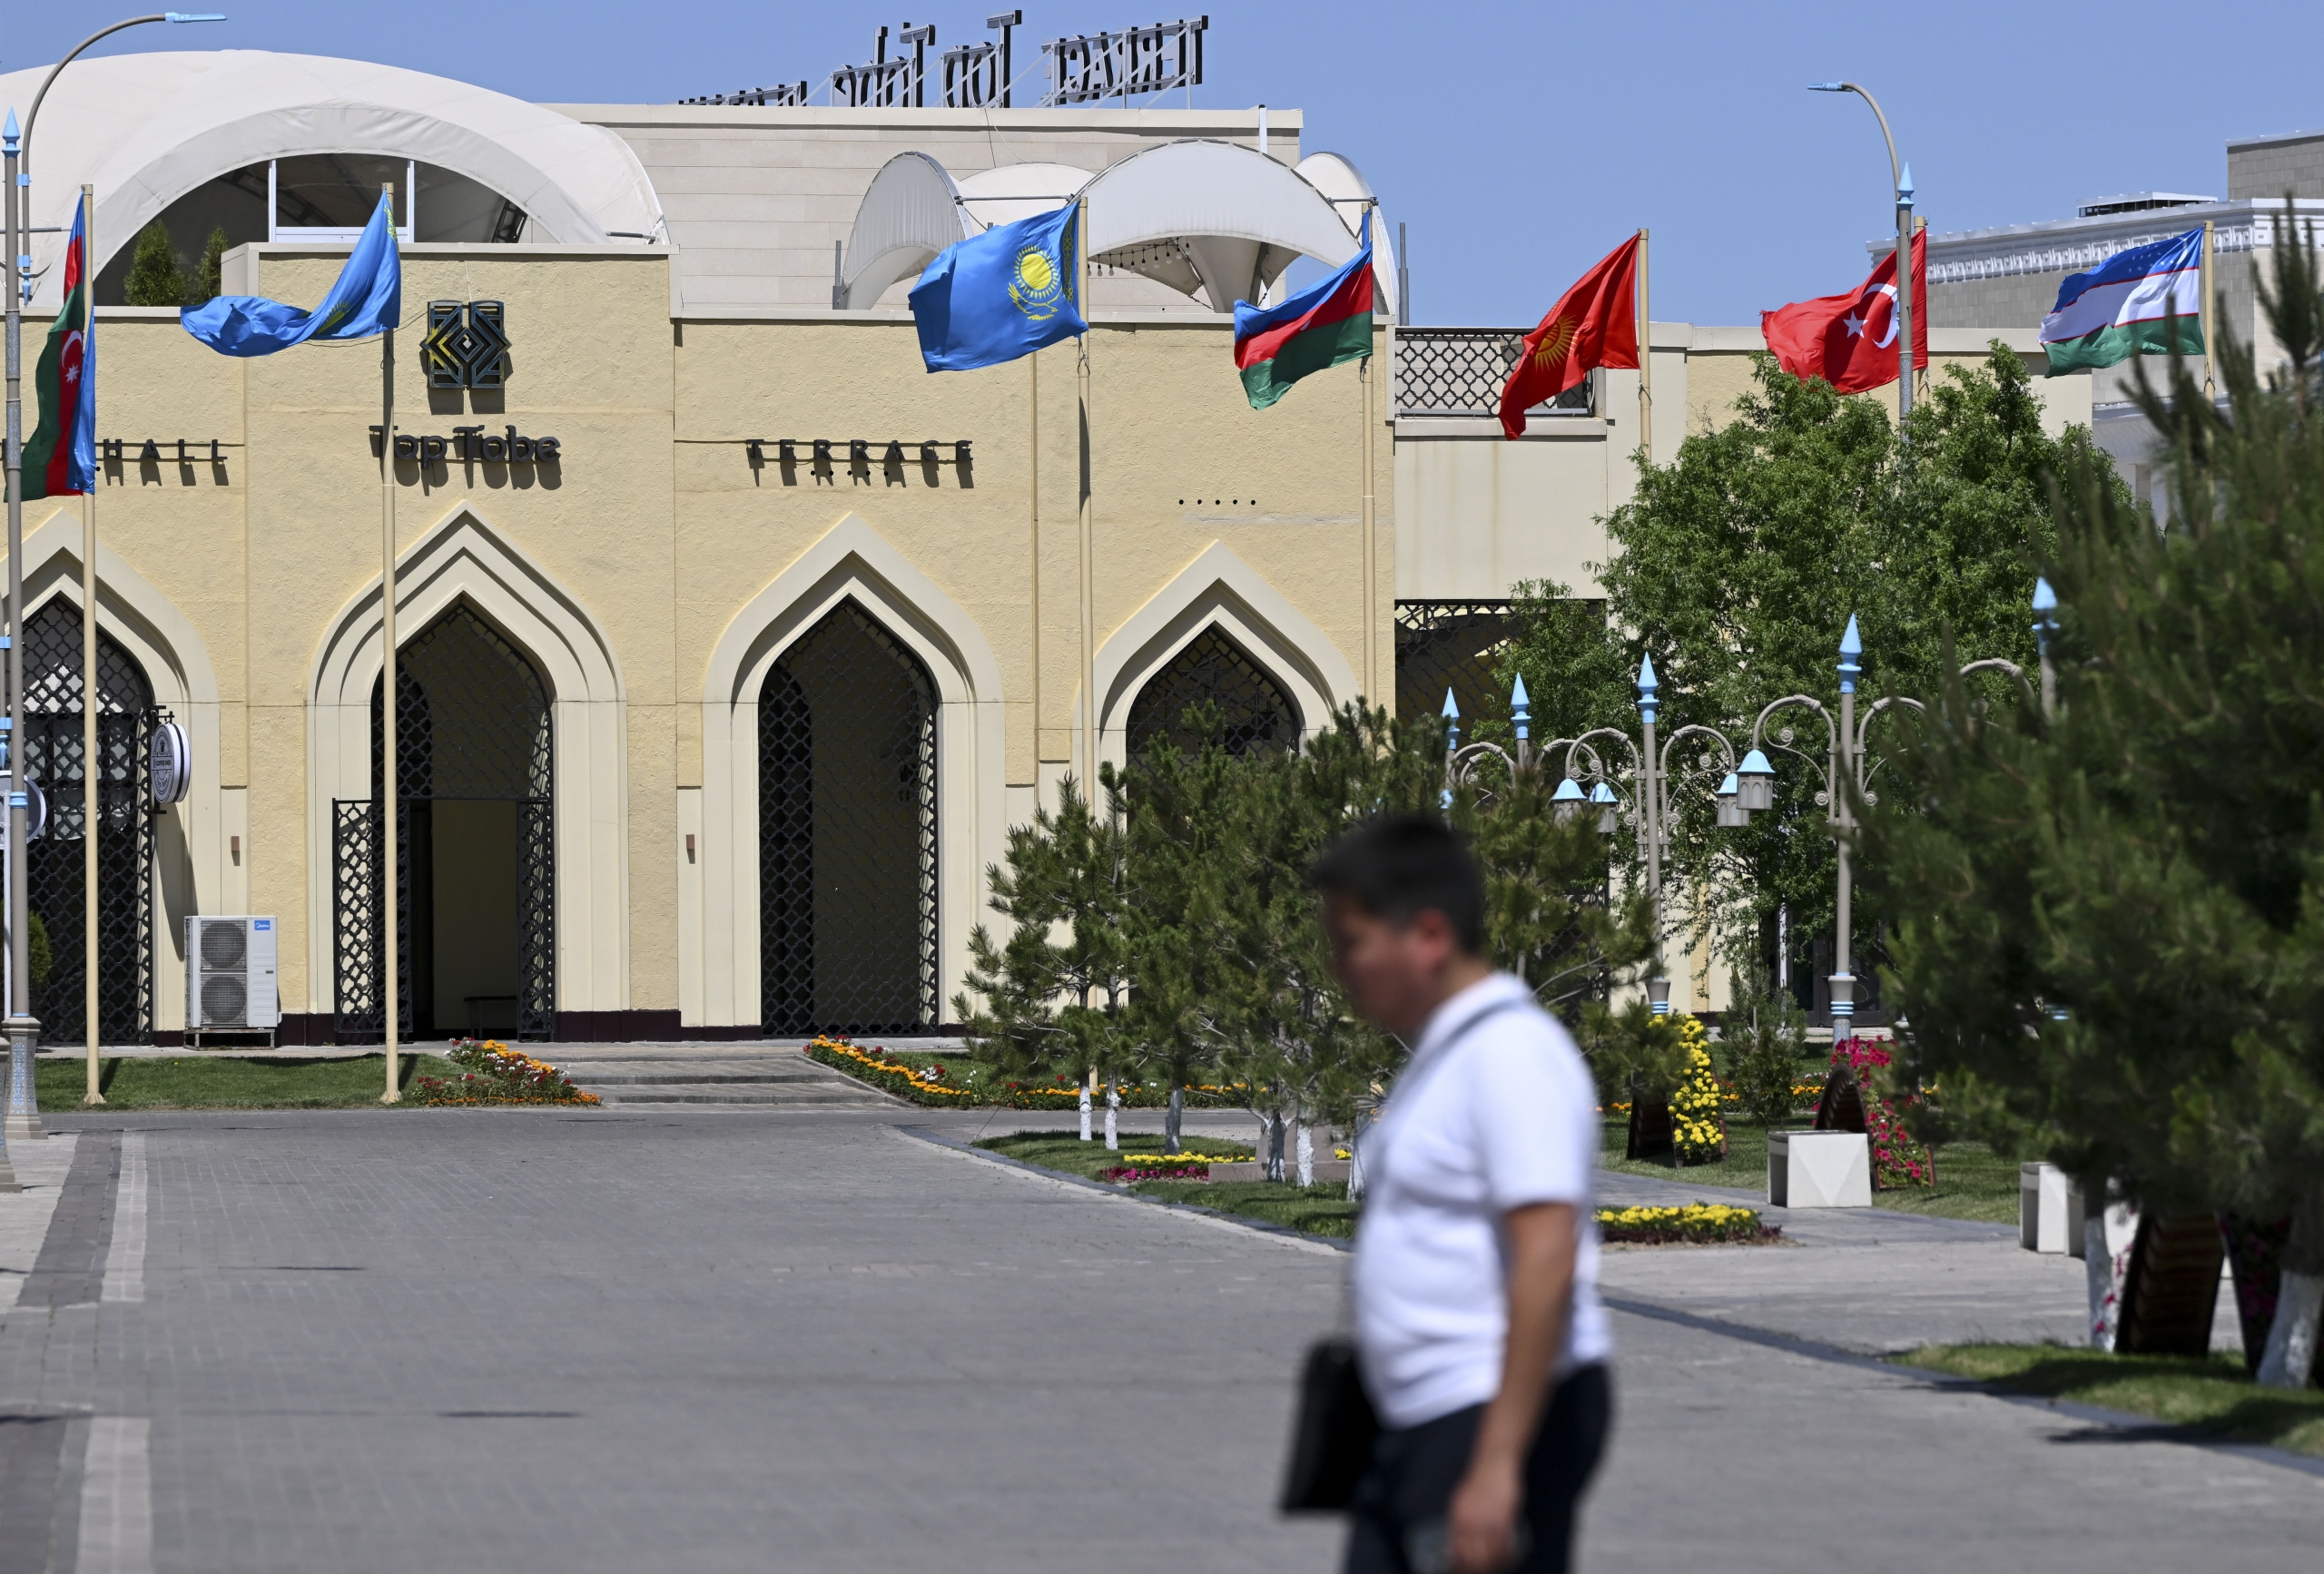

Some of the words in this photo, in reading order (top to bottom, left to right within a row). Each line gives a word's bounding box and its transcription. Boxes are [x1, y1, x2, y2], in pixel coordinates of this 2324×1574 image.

[103, 438, 228, 460] HALL
[369, 425, 448, 469] Top
[452, 425, 561, 462] Tobe
[746, 438, 973, 461] TERRACE
